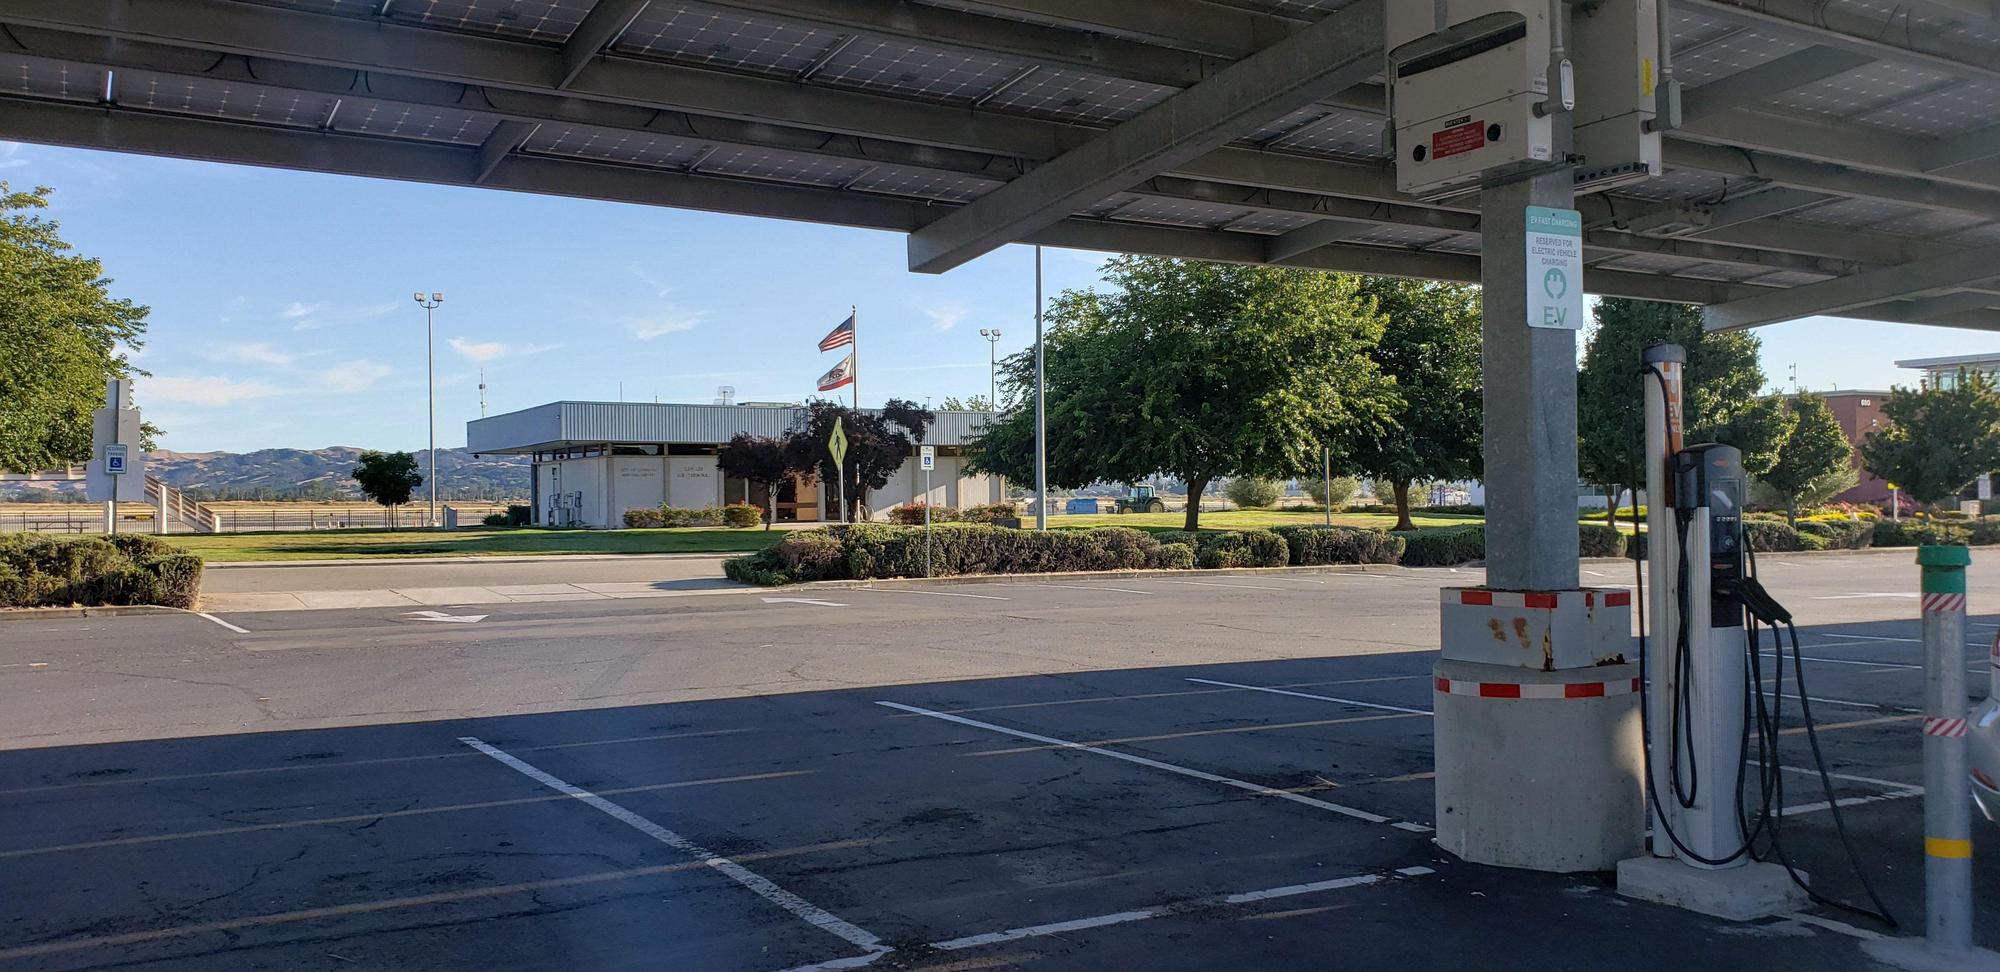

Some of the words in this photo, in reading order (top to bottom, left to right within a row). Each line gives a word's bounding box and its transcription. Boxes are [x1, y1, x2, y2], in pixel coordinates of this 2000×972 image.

[1530, 215, 1538, 224] EV
[1538, 216, 1551, 225] FAST
[1551, 217, 1577, 228] CHARGING
[1535, 236, 1562, 247] RESERVED
[1562, 239, 1573, 248] FOR
[1531, 246, 1556, 256] ELECTRIC
[1556, 248, 1577, 258] VEHICLE
[1541, 257, 1568, 267] CHARGING
[1543, 305, 1568, 327] EV
